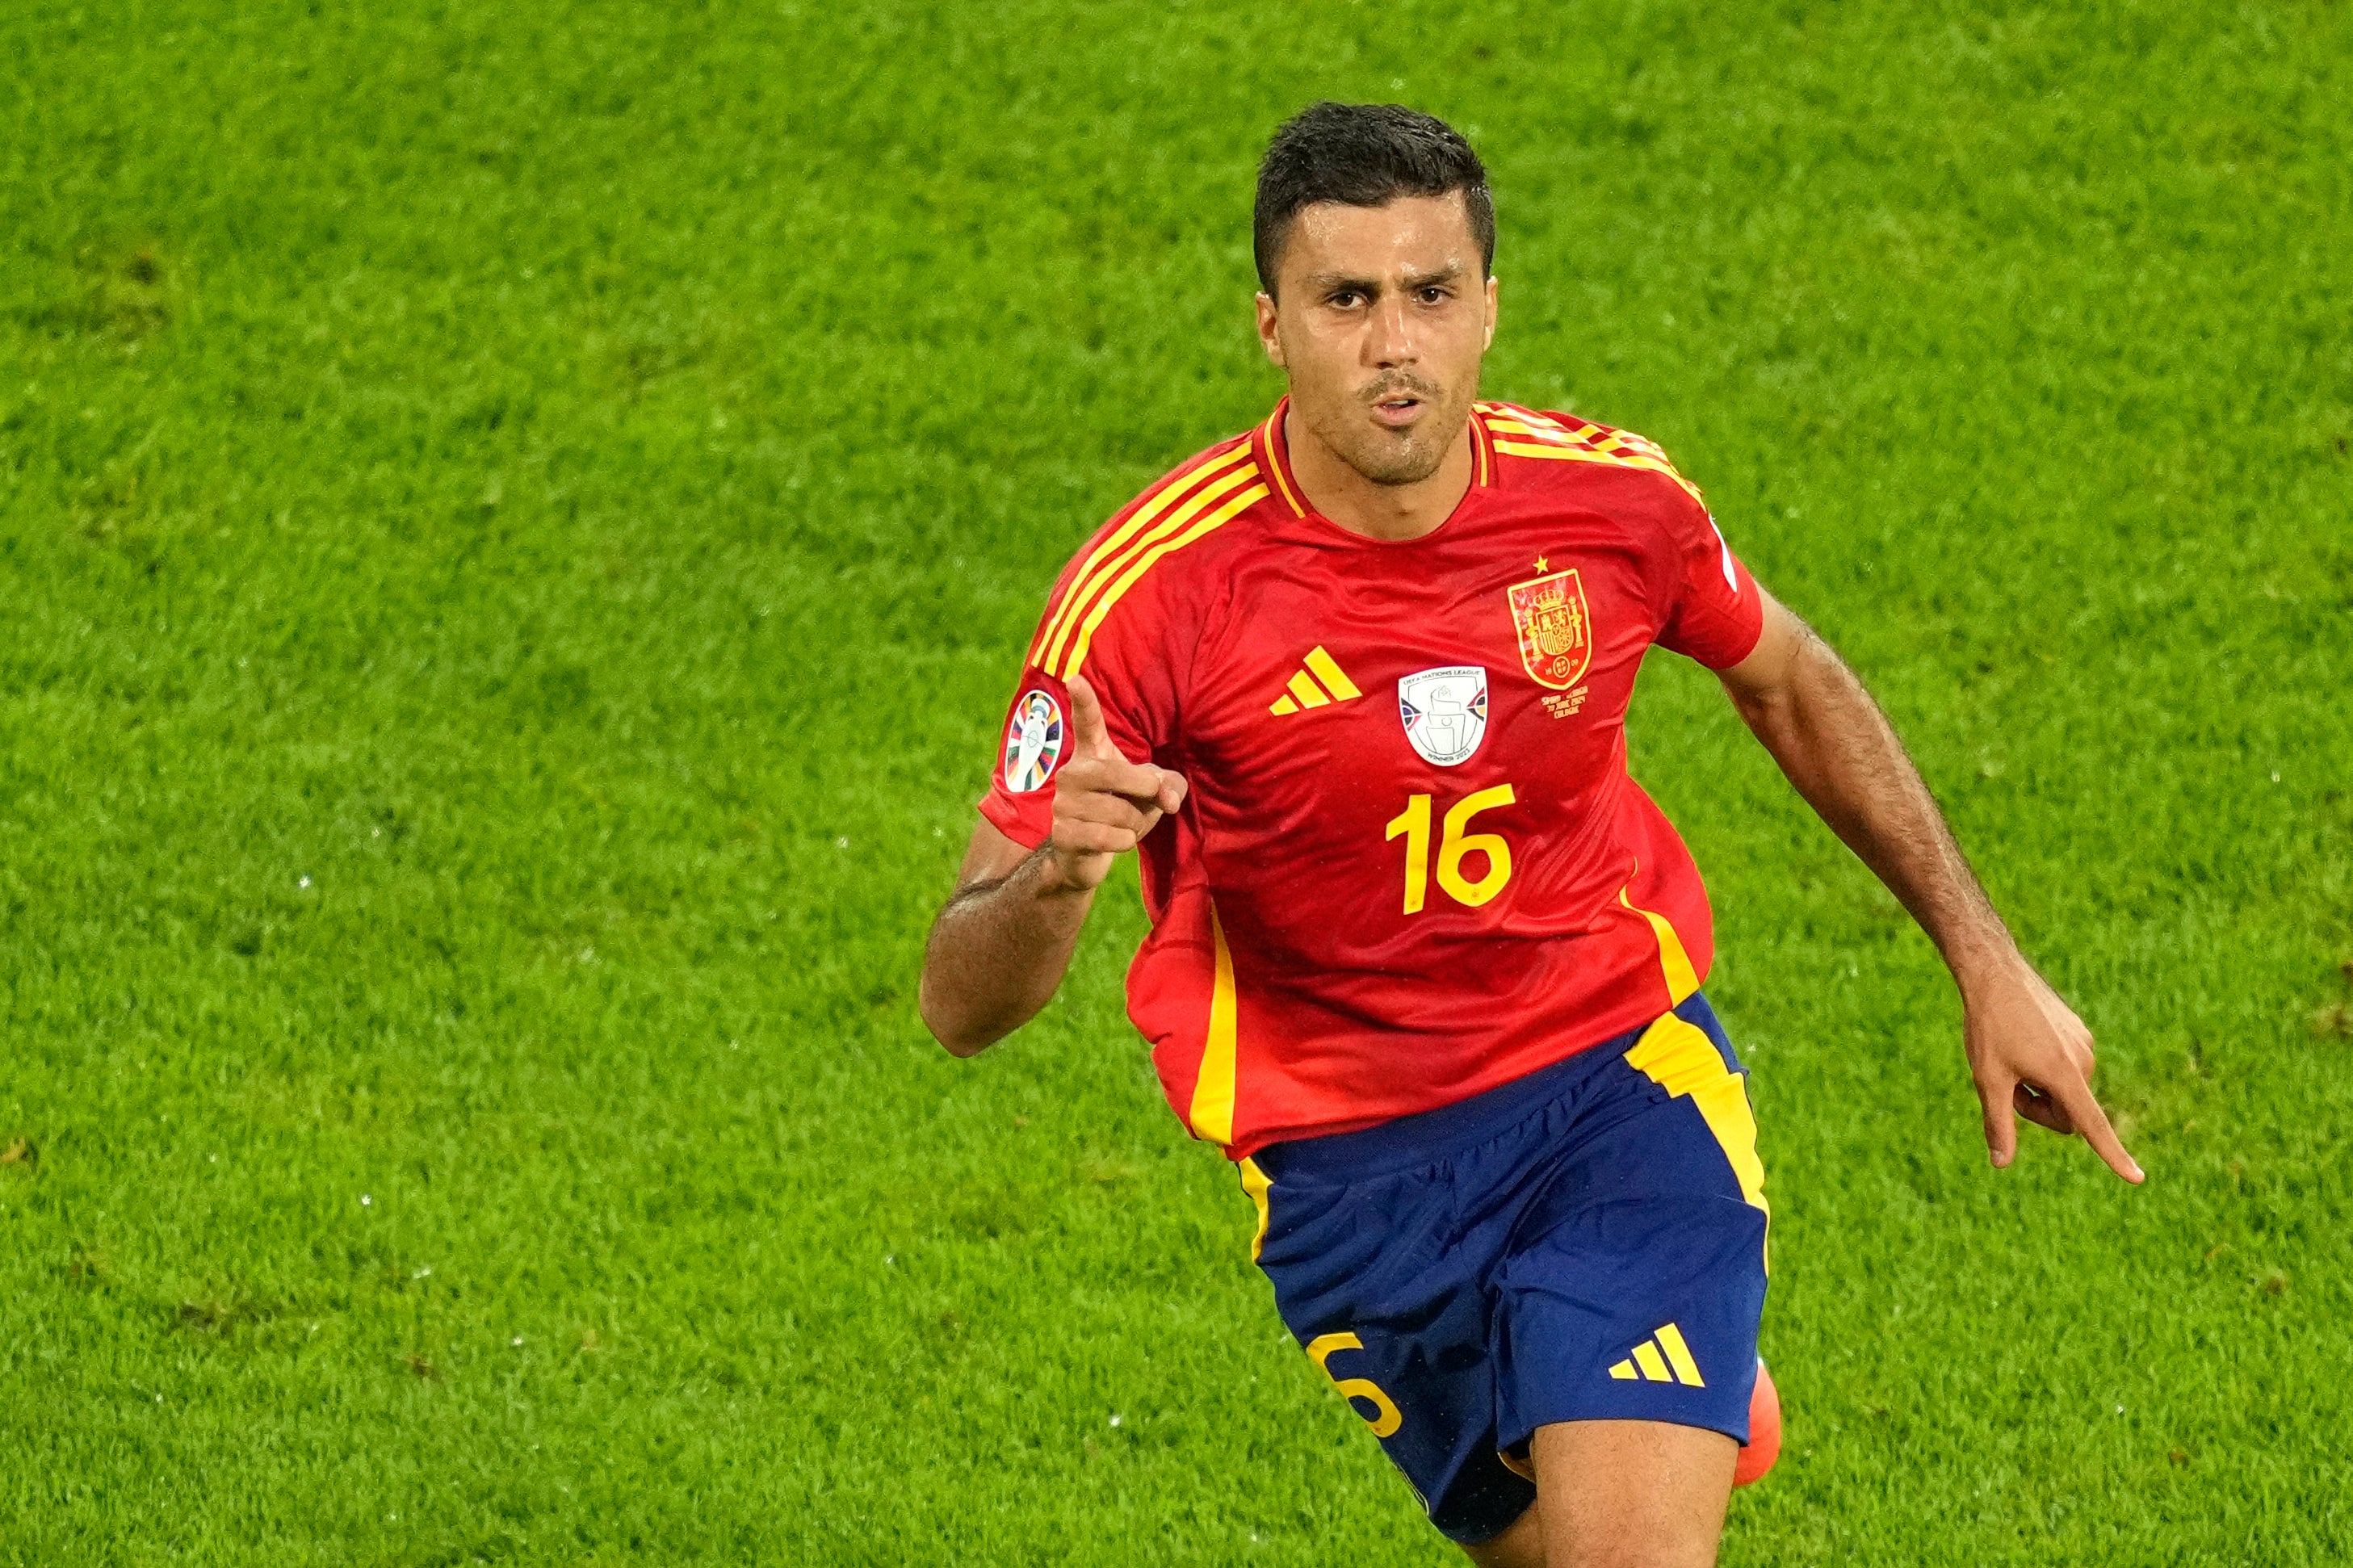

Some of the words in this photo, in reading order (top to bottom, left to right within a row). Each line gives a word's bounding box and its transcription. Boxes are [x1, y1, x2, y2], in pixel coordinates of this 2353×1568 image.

[1403, 677, 1420, 685] UEFA
[1422, 670, 1452, 680] NATIONS
[1428, 752, 1454, 762] WINNER
[1386, 782, 1516, 915] 16
